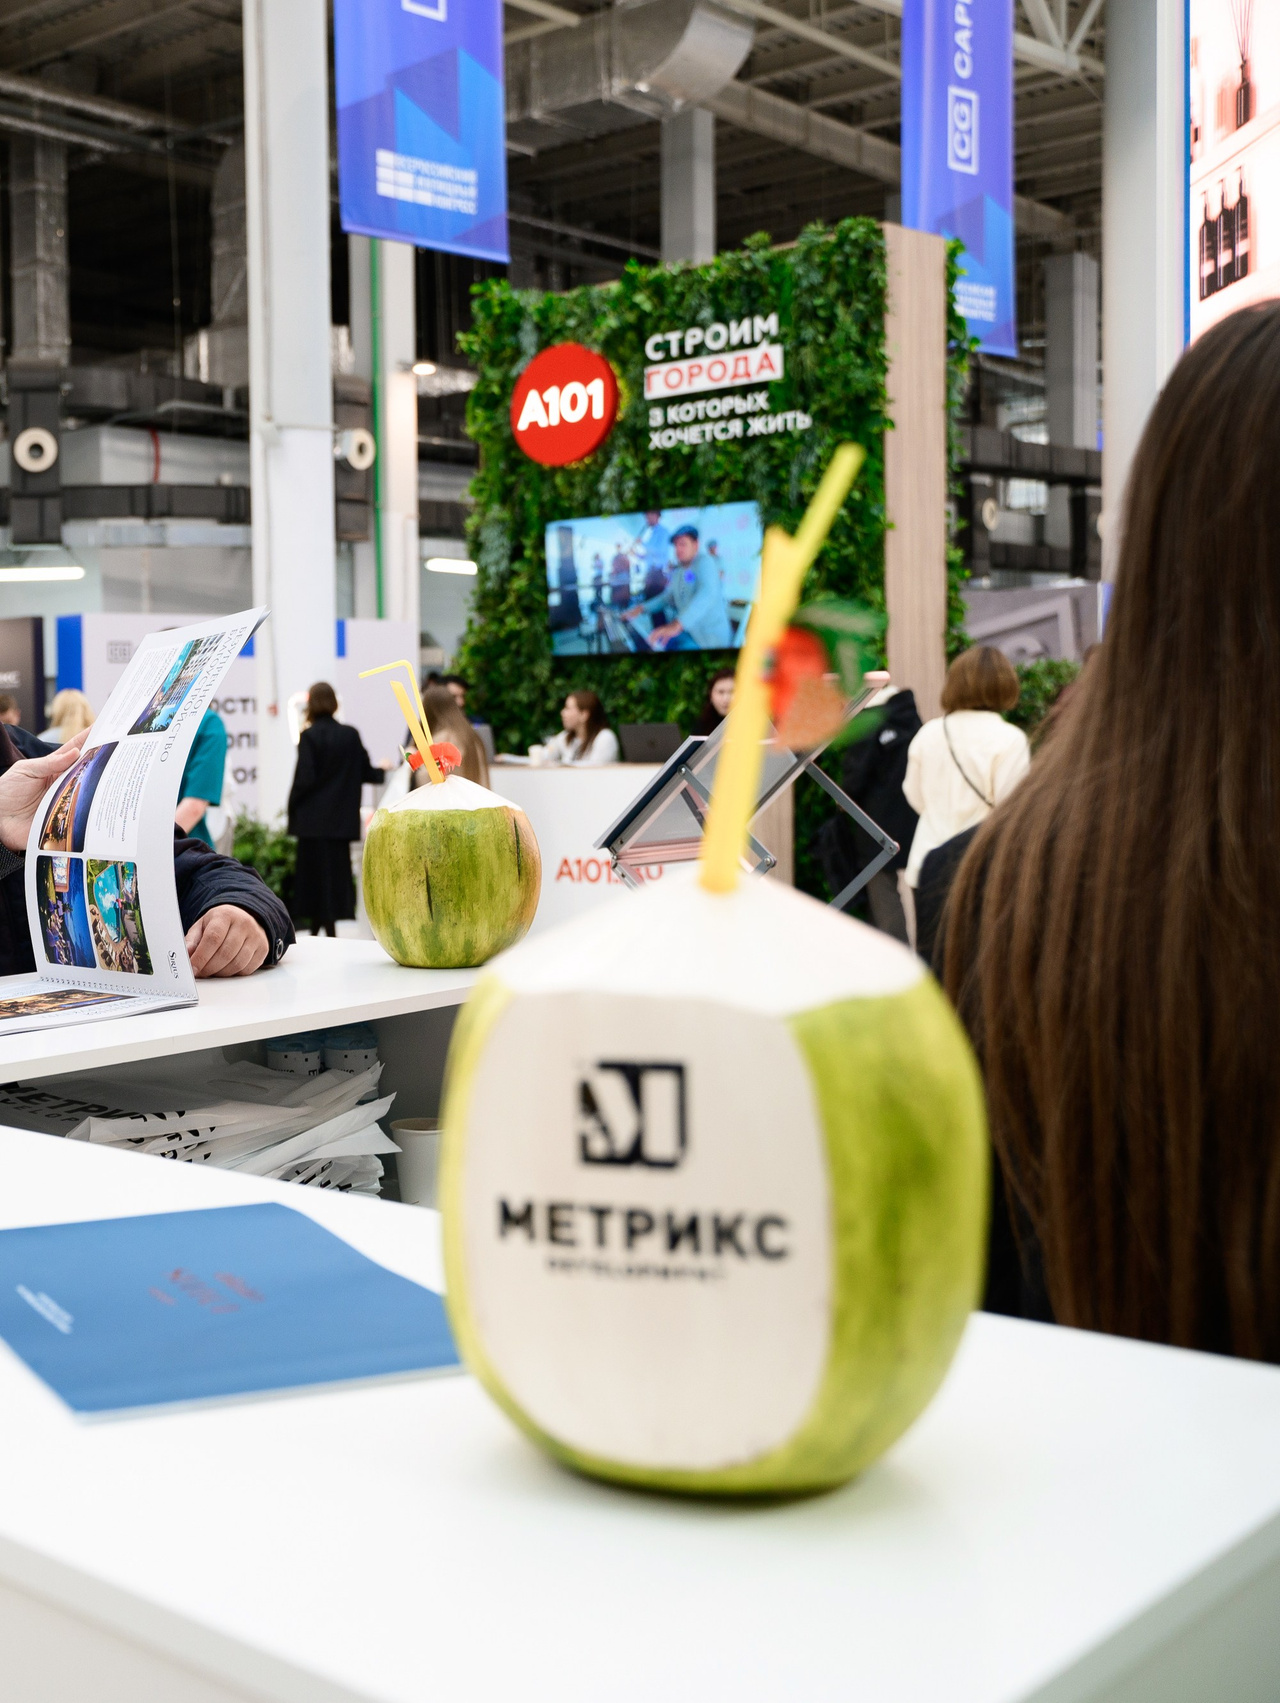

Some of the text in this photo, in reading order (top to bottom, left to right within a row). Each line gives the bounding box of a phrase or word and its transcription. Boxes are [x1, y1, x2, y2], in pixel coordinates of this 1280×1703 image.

[645, 313, 779, 361] СТРОИМ
[646, 352, 776, 393] ГОРОДА
[649, 410, 812, 450] ХОЧЕТСЯ ЖИТЬ
[670, 391, 769, 425] КОТОРЫХ
[160, 628, 238, 763] БЛАГОУСТРОЙСТВО
[498, 1196, 790, 1261] МЕТРИКС
